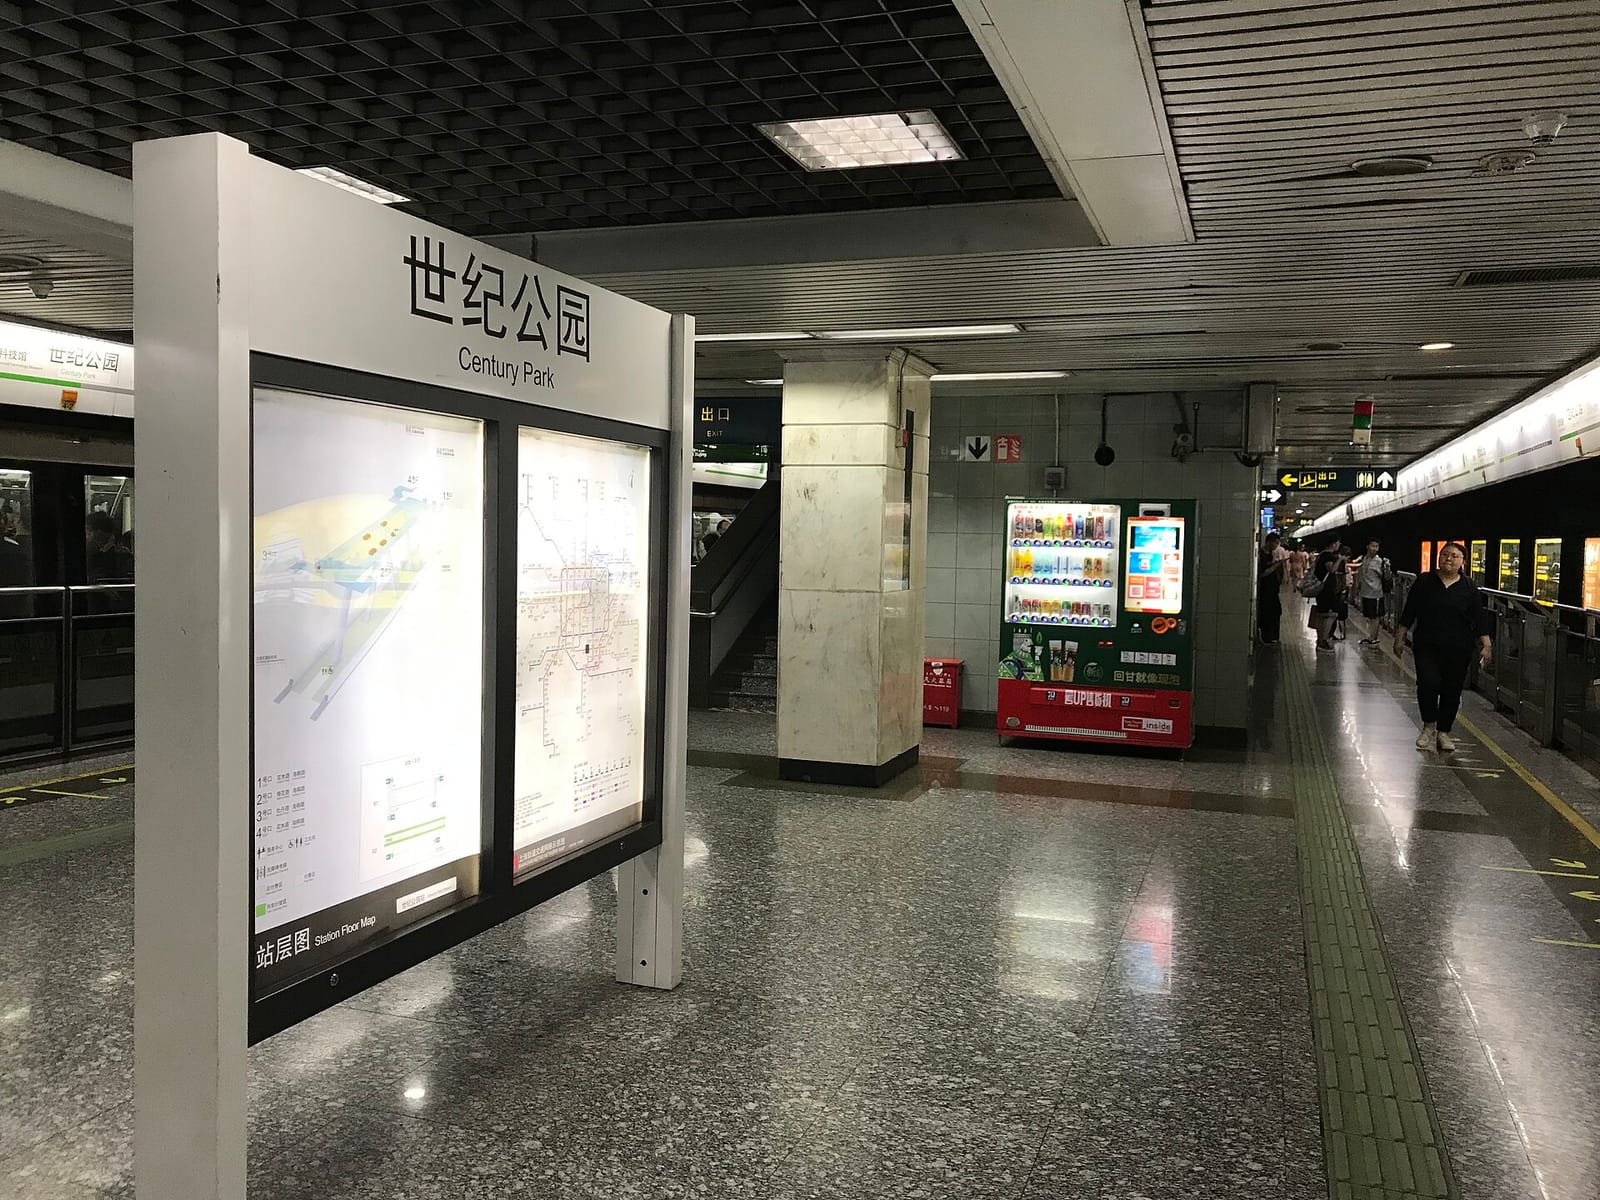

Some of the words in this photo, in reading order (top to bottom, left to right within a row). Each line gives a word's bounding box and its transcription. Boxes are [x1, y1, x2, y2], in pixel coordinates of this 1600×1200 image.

[403, 235, 590, 363] 世纪公园
[49, 344, 119, 372] 世纪公园
[458, 346, 519, 386] Century
[523, 361, 555, 389] Park
[701, 406, 730, 421] 出口
[1318, 471, 1337, 480] 出口
[1145, 722, 1172, 733] inside
[315, 929, 340, 947] Station
[341, 922, 360, 938] Floor
[360, 915, 376, 930] Map
[256, 927, 310, 969] 站层图
